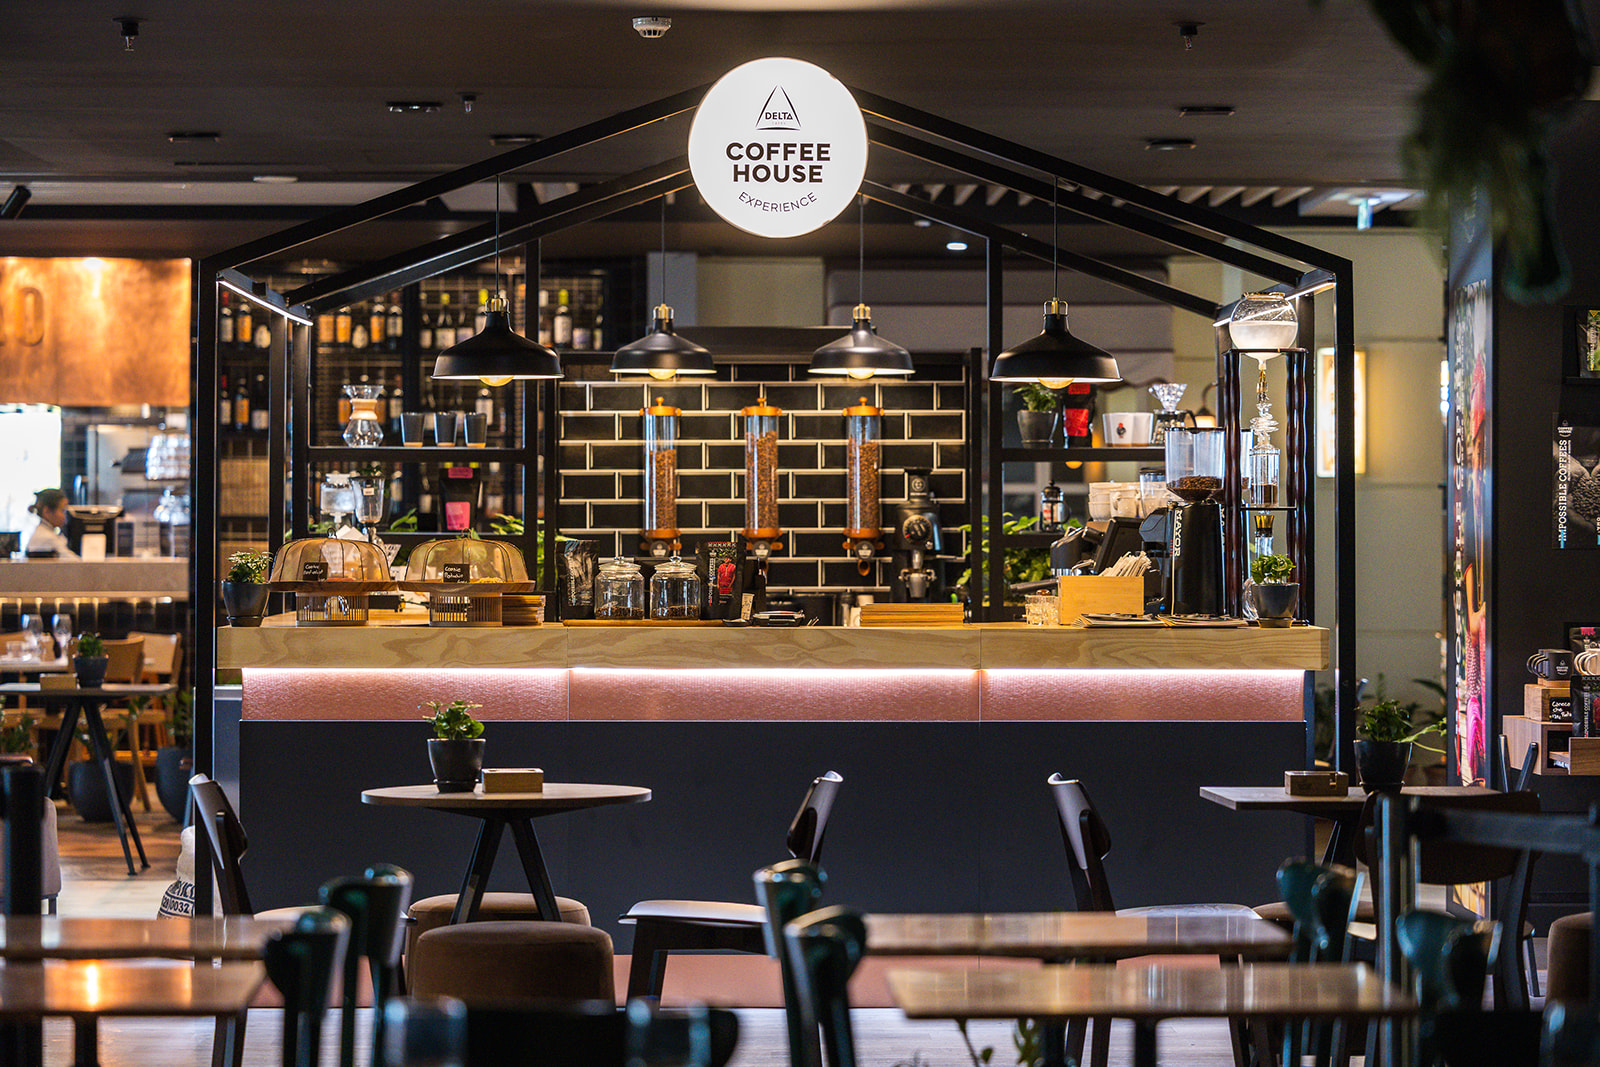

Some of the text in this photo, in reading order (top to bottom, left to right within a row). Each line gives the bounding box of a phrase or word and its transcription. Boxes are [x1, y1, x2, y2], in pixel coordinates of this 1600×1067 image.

[765, 111, 793, 120] DELTA
[726, 142, 831, 161] COFFEE
[733, 164, 823, 183] HOUSE
[738, 191, 818, 212] EXPERIENCE
[1558, 439, 1568, 541] IMPOSSIBLE COFFEES
[1174, 509, 1183, 557] MAYOR
